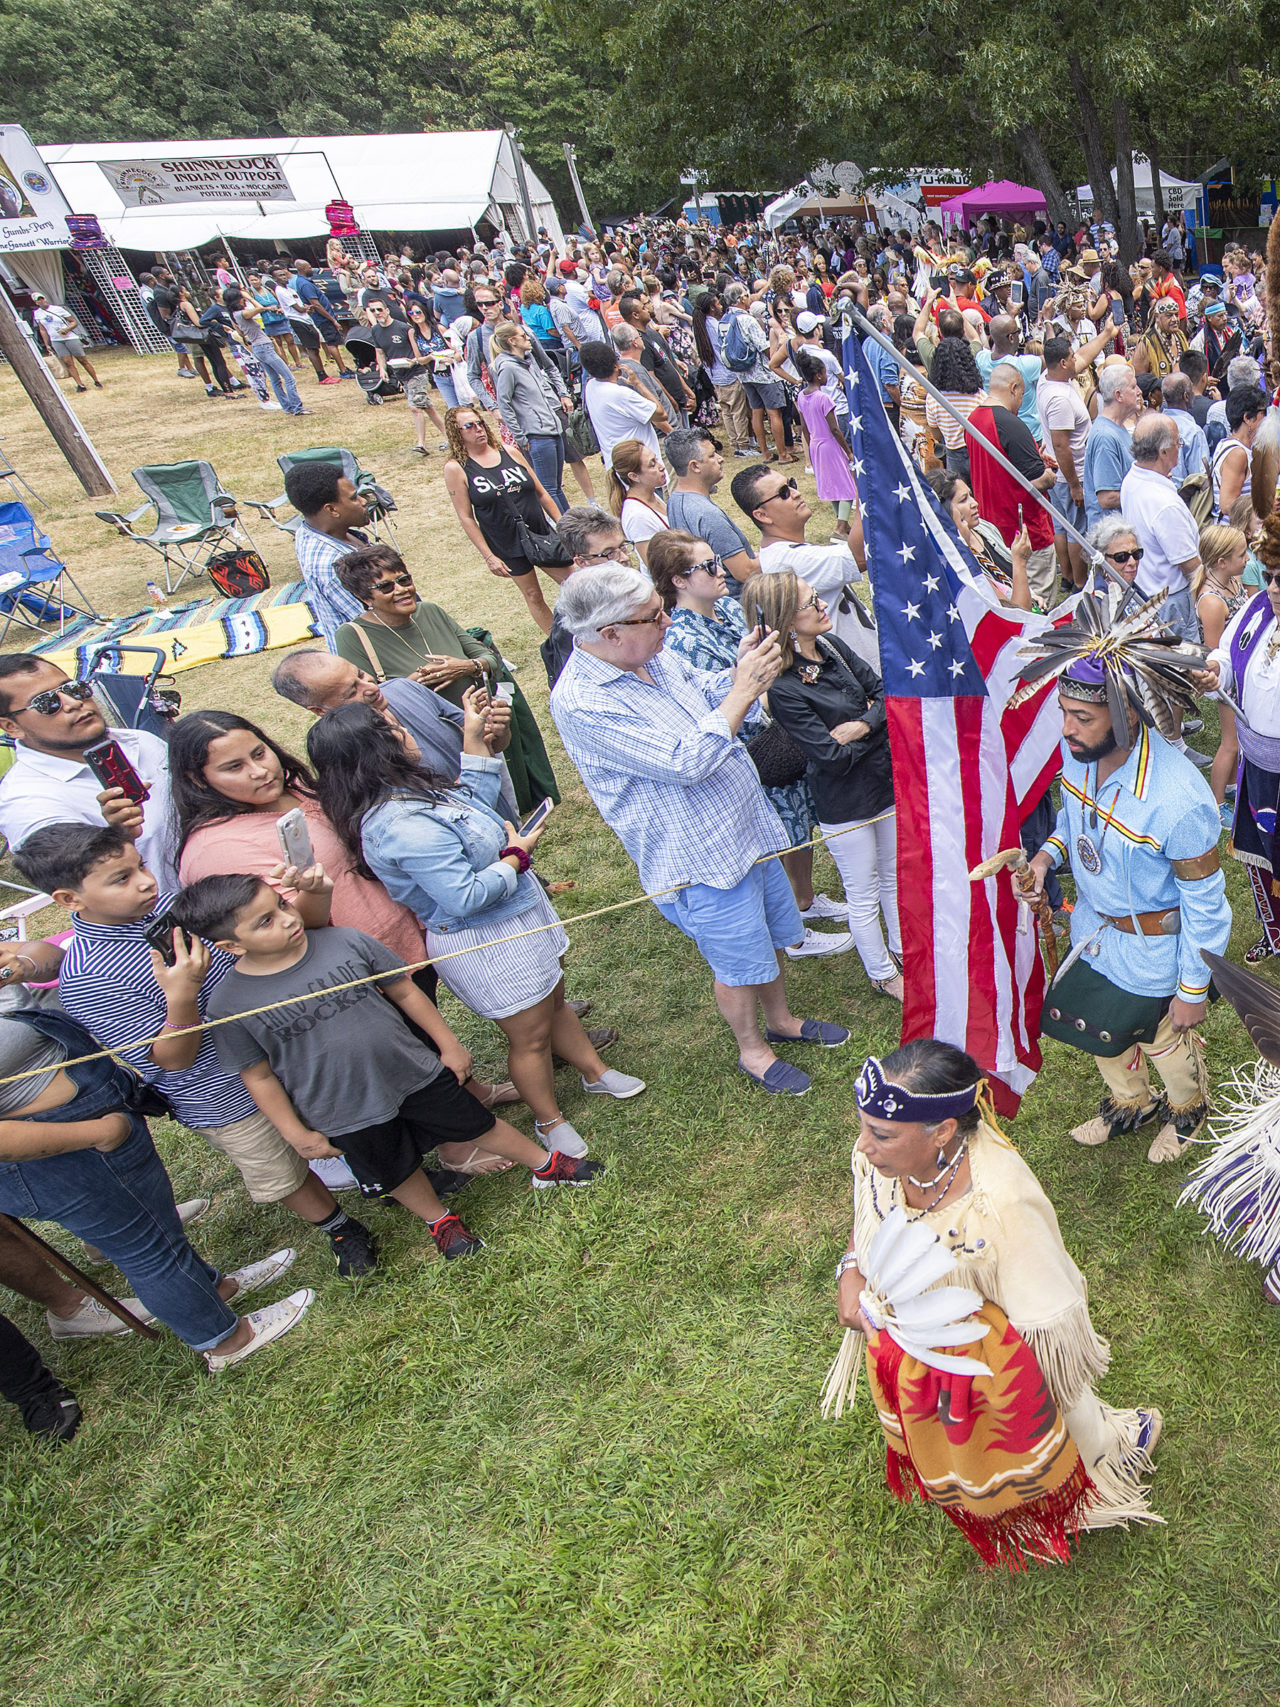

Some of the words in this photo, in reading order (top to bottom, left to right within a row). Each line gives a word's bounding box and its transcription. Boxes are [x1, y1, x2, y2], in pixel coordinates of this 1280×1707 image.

[161, 156, 278, 173] SHINNECOCK
[172, 172, 222, 182] INDIAN
[224, 171, 283, 181] OUTPOST
[174, 184, 215, 192] BLANKETS
[1168, 187, 1183, 195] CBD
[1168, 194, 1184, 202] Sold
[272, 983, 369, 1044] ROCKS
